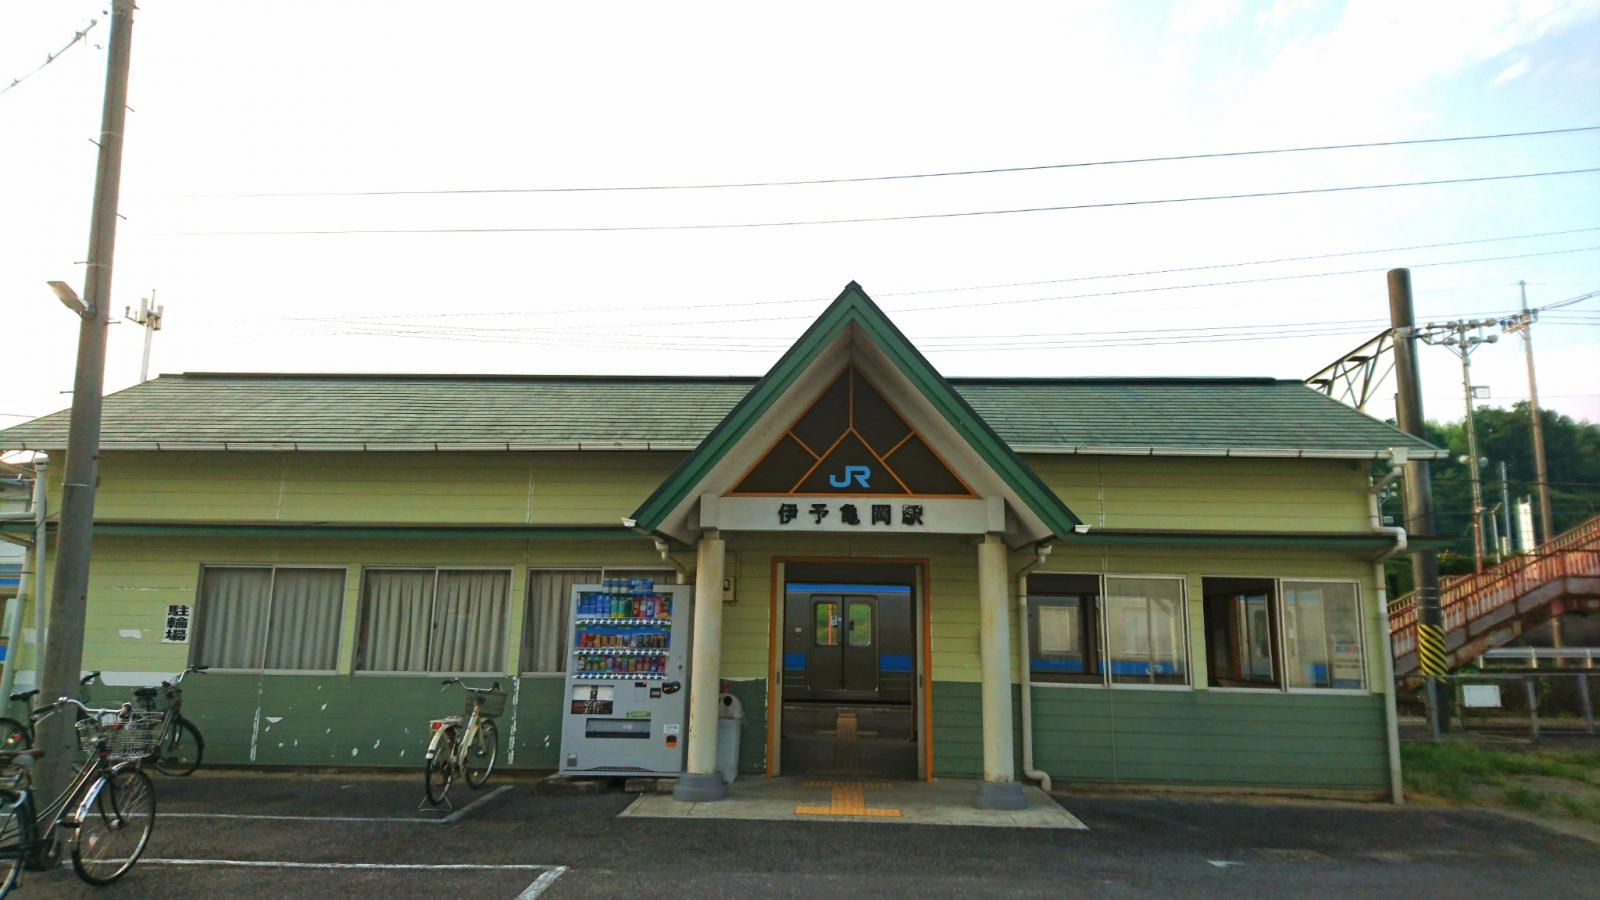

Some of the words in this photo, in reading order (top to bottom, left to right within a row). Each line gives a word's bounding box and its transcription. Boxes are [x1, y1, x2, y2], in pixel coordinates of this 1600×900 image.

[829, 466, 871, 487] JR
[778, 503, 924, 525] 伊予亀岡駅
[166, 605, 189, 640] 駐輪場
